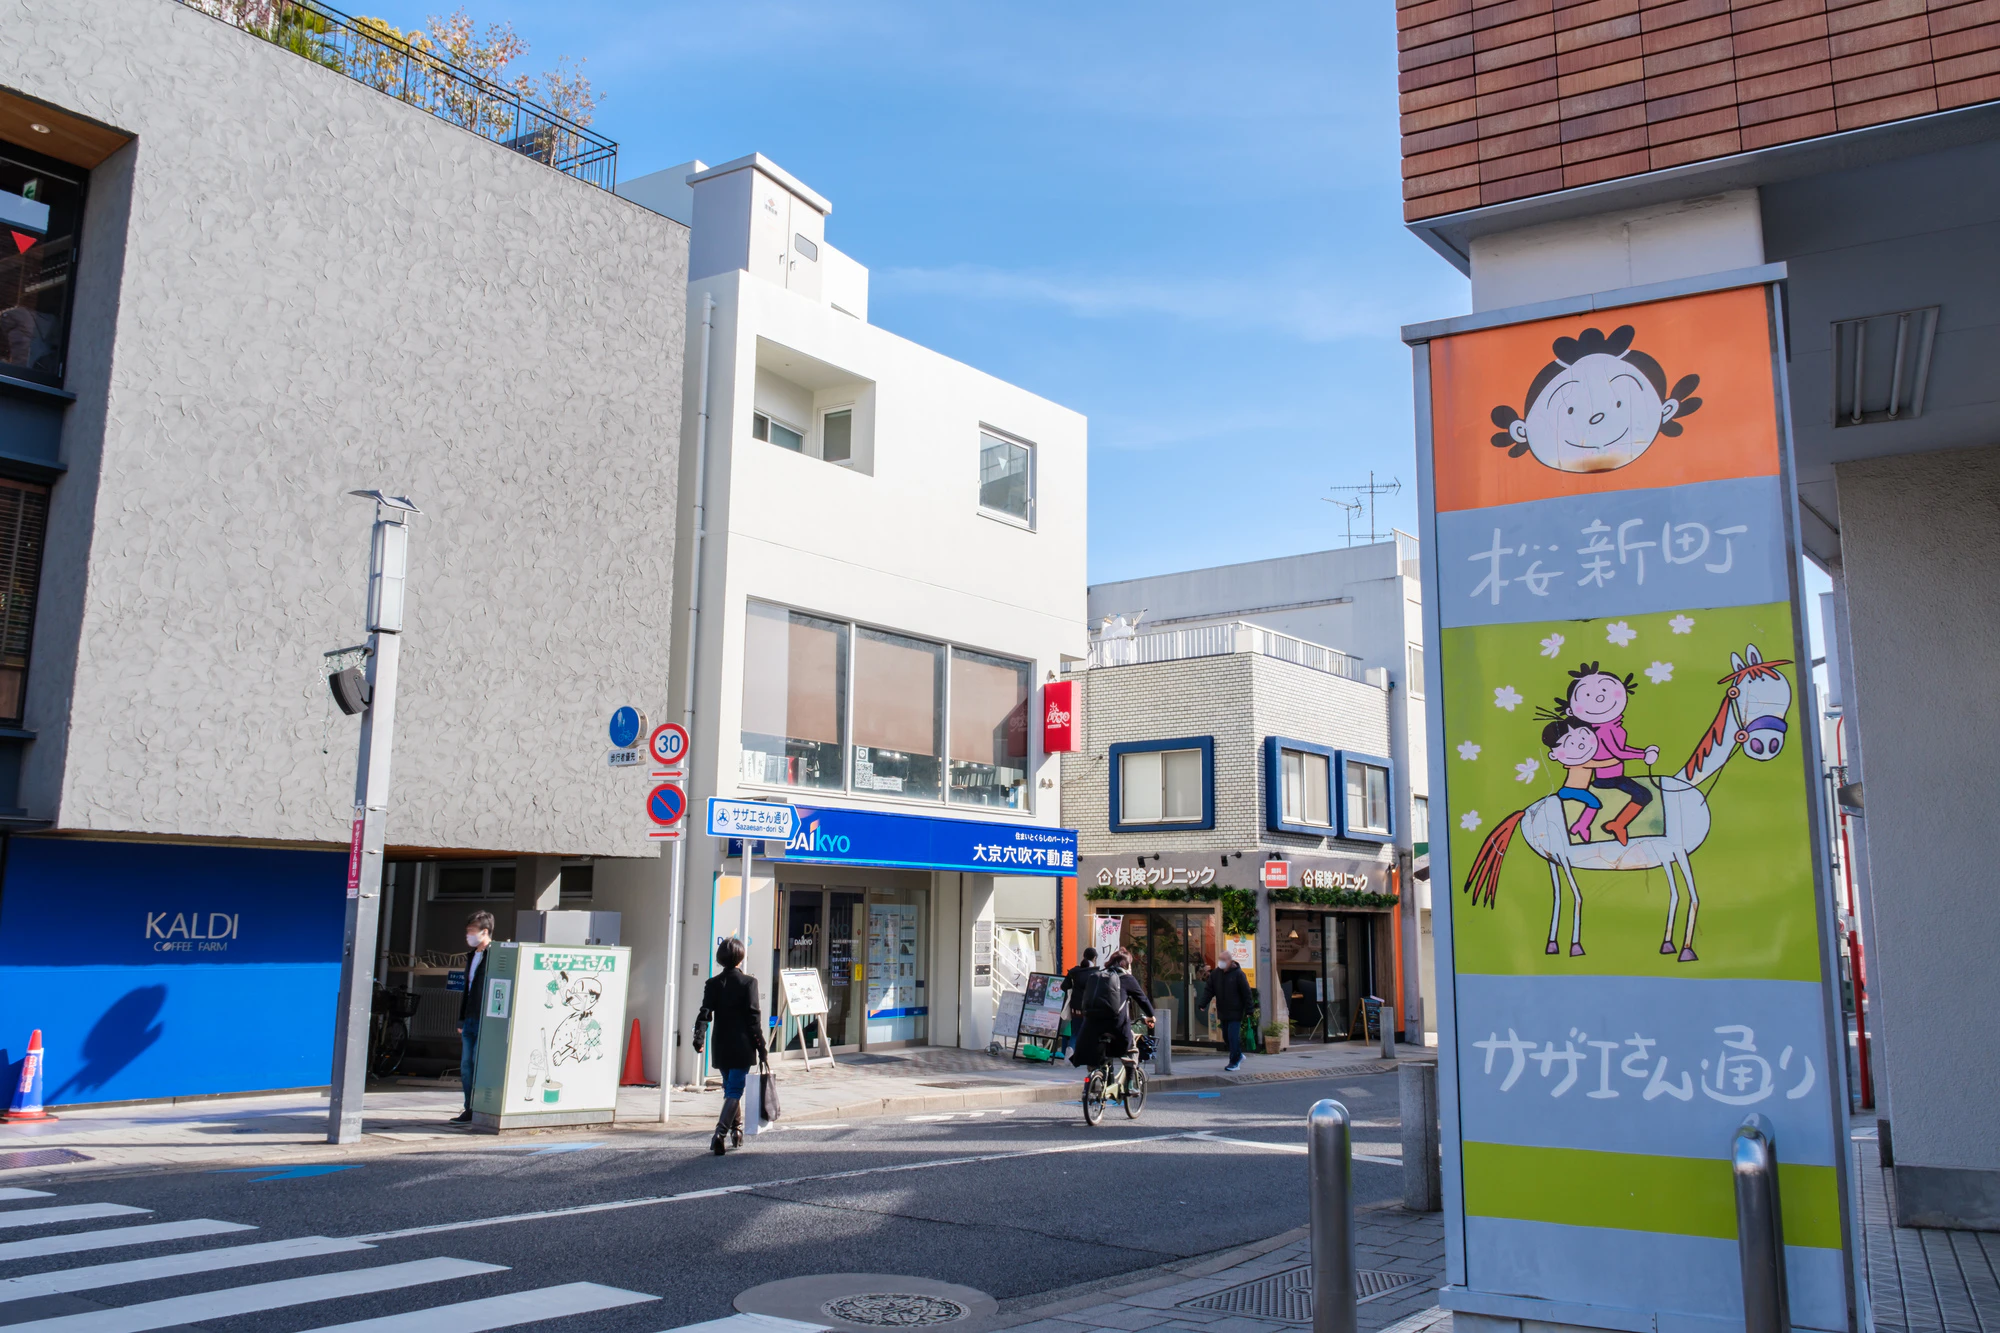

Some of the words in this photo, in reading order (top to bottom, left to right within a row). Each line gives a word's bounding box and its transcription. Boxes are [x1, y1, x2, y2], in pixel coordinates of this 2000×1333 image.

[1468, 518, 1748, 605] 桜新町
[658, 734, 681, 753] 30
[610, 752, 636, 763] 歩行者優先
[732, 808, 789, 825] サザエさん通り
[735, 822, 777, 833] Sazaesan-dori
[778, 826, 786, 834] St.
[735, 839, 758, 849] 不産
[1015, 832, 1074, 844] 住まいとくらしのパートナー
[351, 823, 361, 878] サザエさん通り
[972, 843, 1075, 868] 大京穴吹不動産
[1114, 866, 1216, 886] 保険クリニック
[1314, 869, 1369, 891] 保険クリニック
[145, 911, 239, 939] KALDI
[153, 941, 193, 952] COFFEE
[198, 941, 228, 952] FARM
[540, 953, 613, 971] サザエさん
[1472, 1025, 1816, 1106] サザエさん通り
